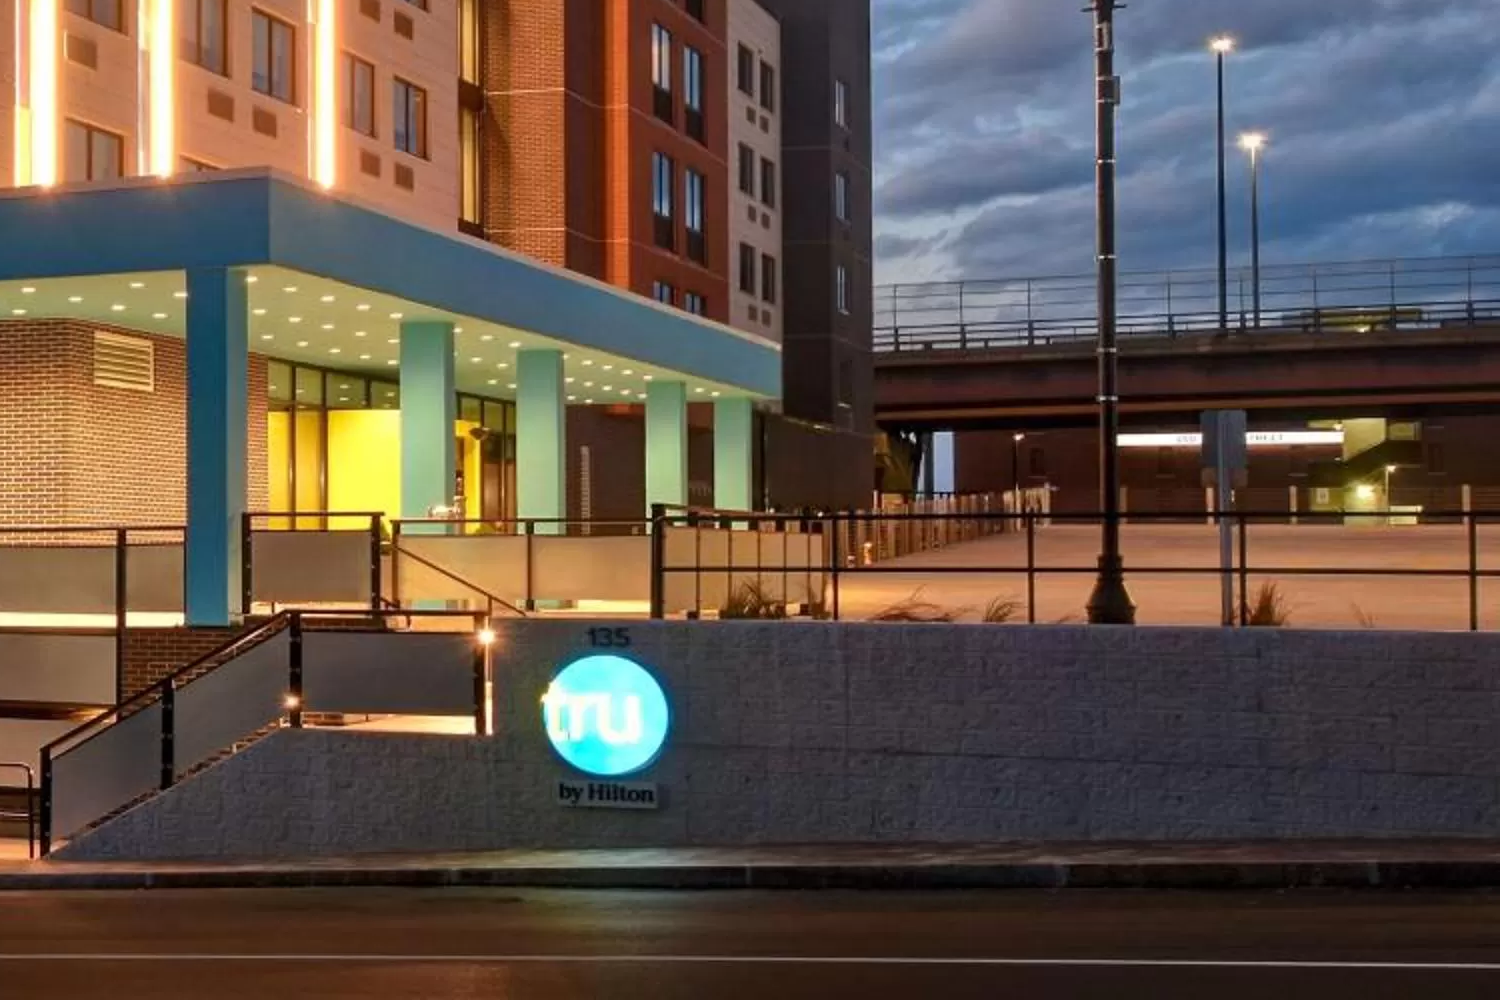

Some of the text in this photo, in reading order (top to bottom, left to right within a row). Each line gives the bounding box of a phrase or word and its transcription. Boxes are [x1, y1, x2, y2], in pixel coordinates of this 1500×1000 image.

[587, 627, 631, 648] 135
[540, 681, 644, 745] tru
[559, 783, 654, 806] by Hilton
